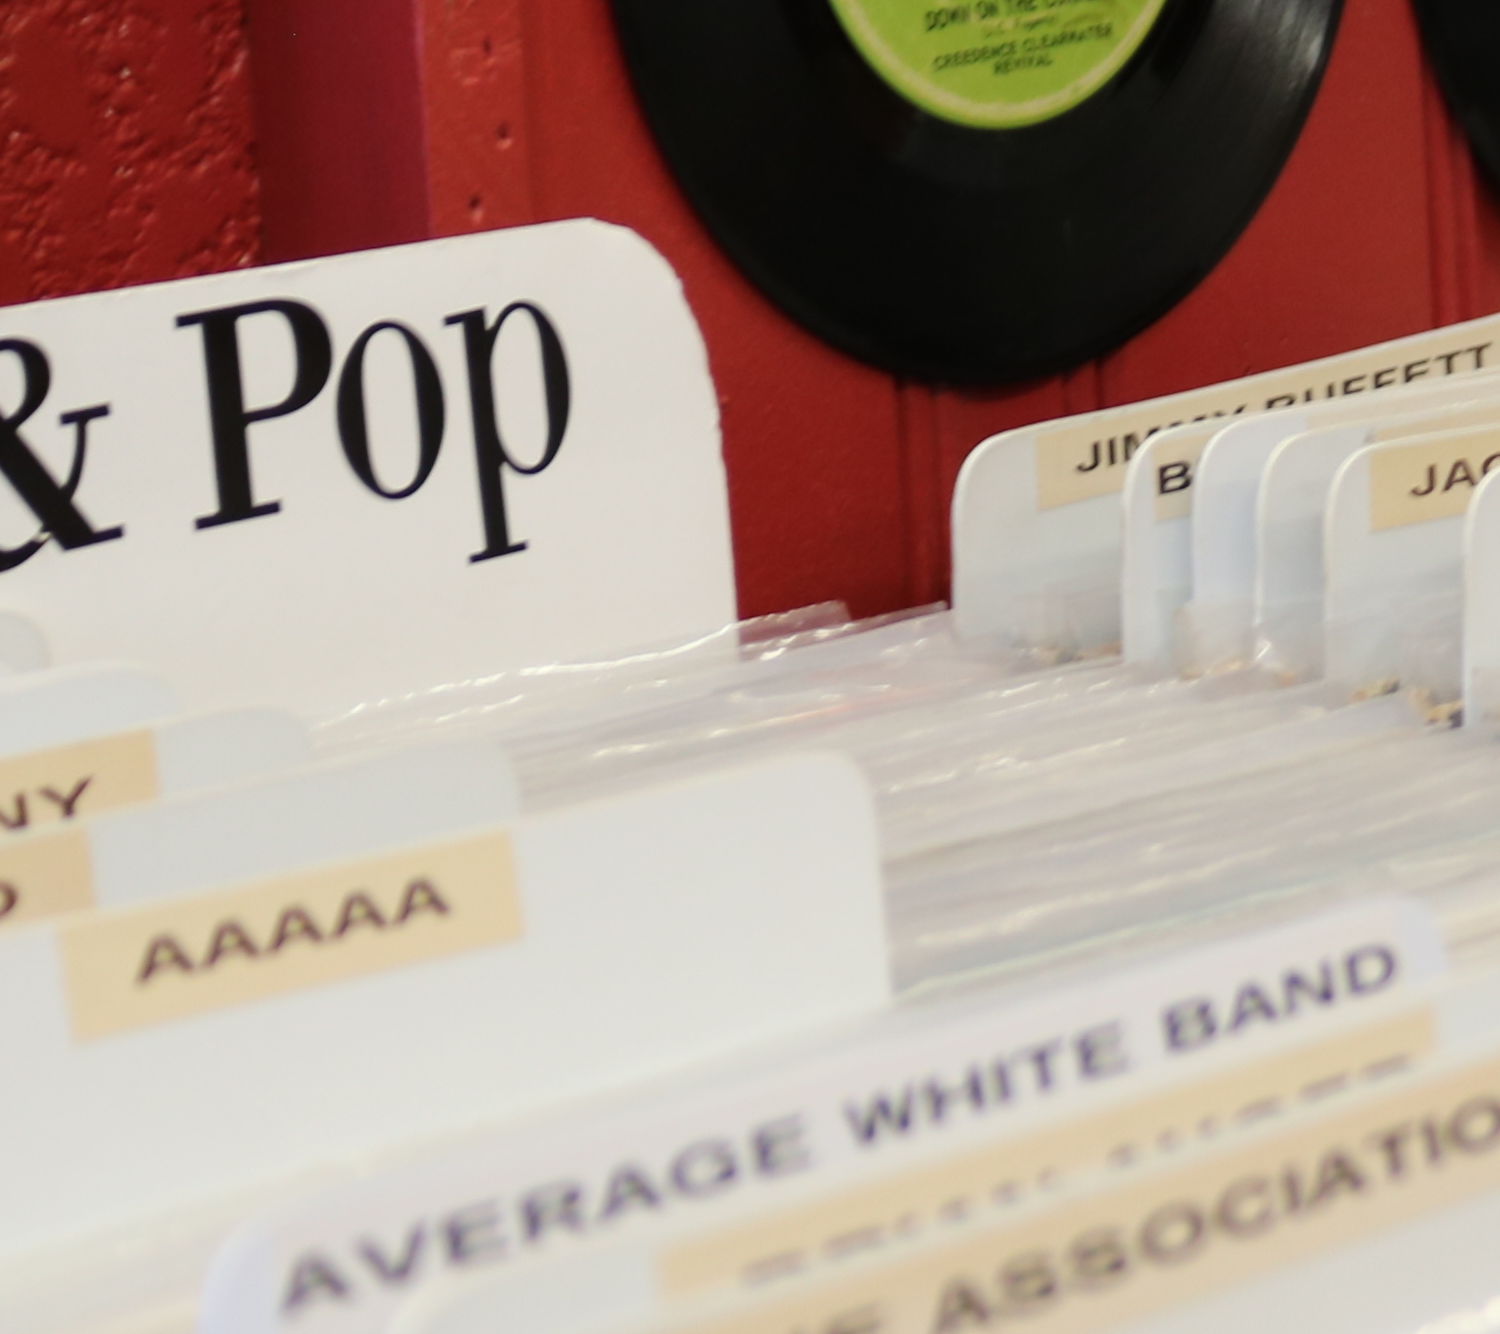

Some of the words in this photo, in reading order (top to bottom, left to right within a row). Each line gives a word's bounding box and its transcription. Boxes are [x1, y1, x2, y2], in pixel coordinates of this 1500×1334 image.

[171, 291, 574, 566] Pop
[134, 876, 453, 988] AAAAA
[277, 1110, 821, 1324] AVERAGE
[842, 1017, 1131, 1153] WHITE
[1161, 944, 1400, 1057] BAND
